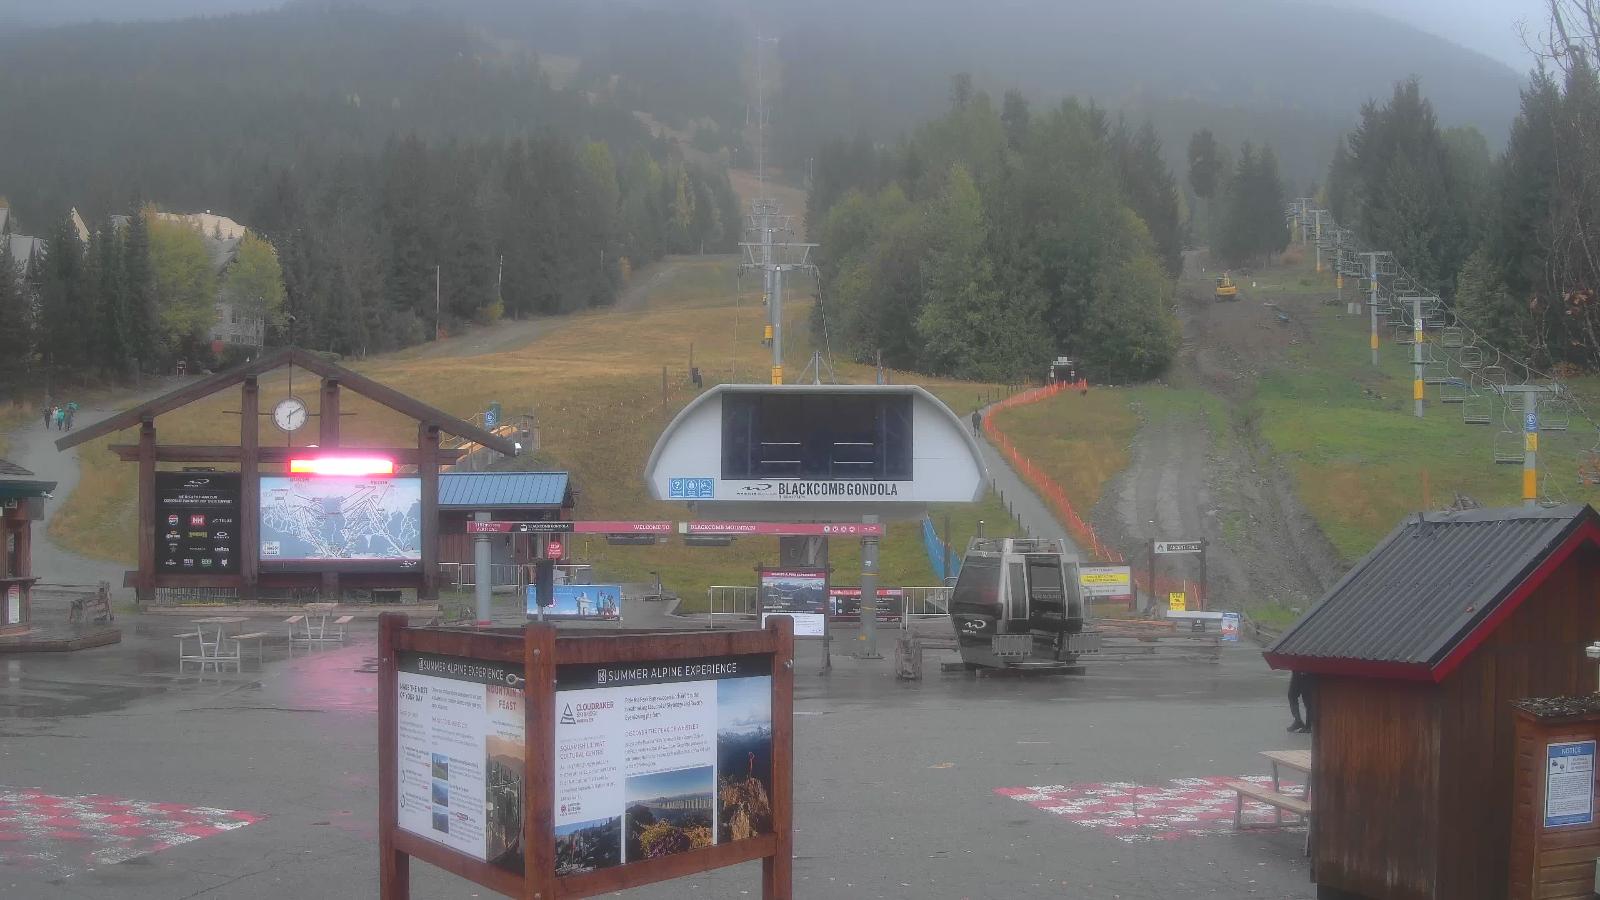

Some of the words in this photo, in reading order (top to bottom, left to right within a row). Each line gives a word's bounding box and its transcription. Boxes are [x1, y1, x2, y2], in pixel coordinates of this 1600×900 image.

[778, 482, 845, 496] BLACKCOMB
[846, 483, 898, 496] GONDOLA
[423, 660, 446, 672] SUMMER
[447, 662, 467, 676] ALPINE
[468, 665, 504, 681] EXPERIENCE
[608, 668, 648, 681] SUMMER
[650, 666, 683, 679] ALPINE
[685, 662, 737, 677] EXPERIENCE
[498, 699, 517, 711] FEAST
[1561, 746, 1582, 755] NOTICE
